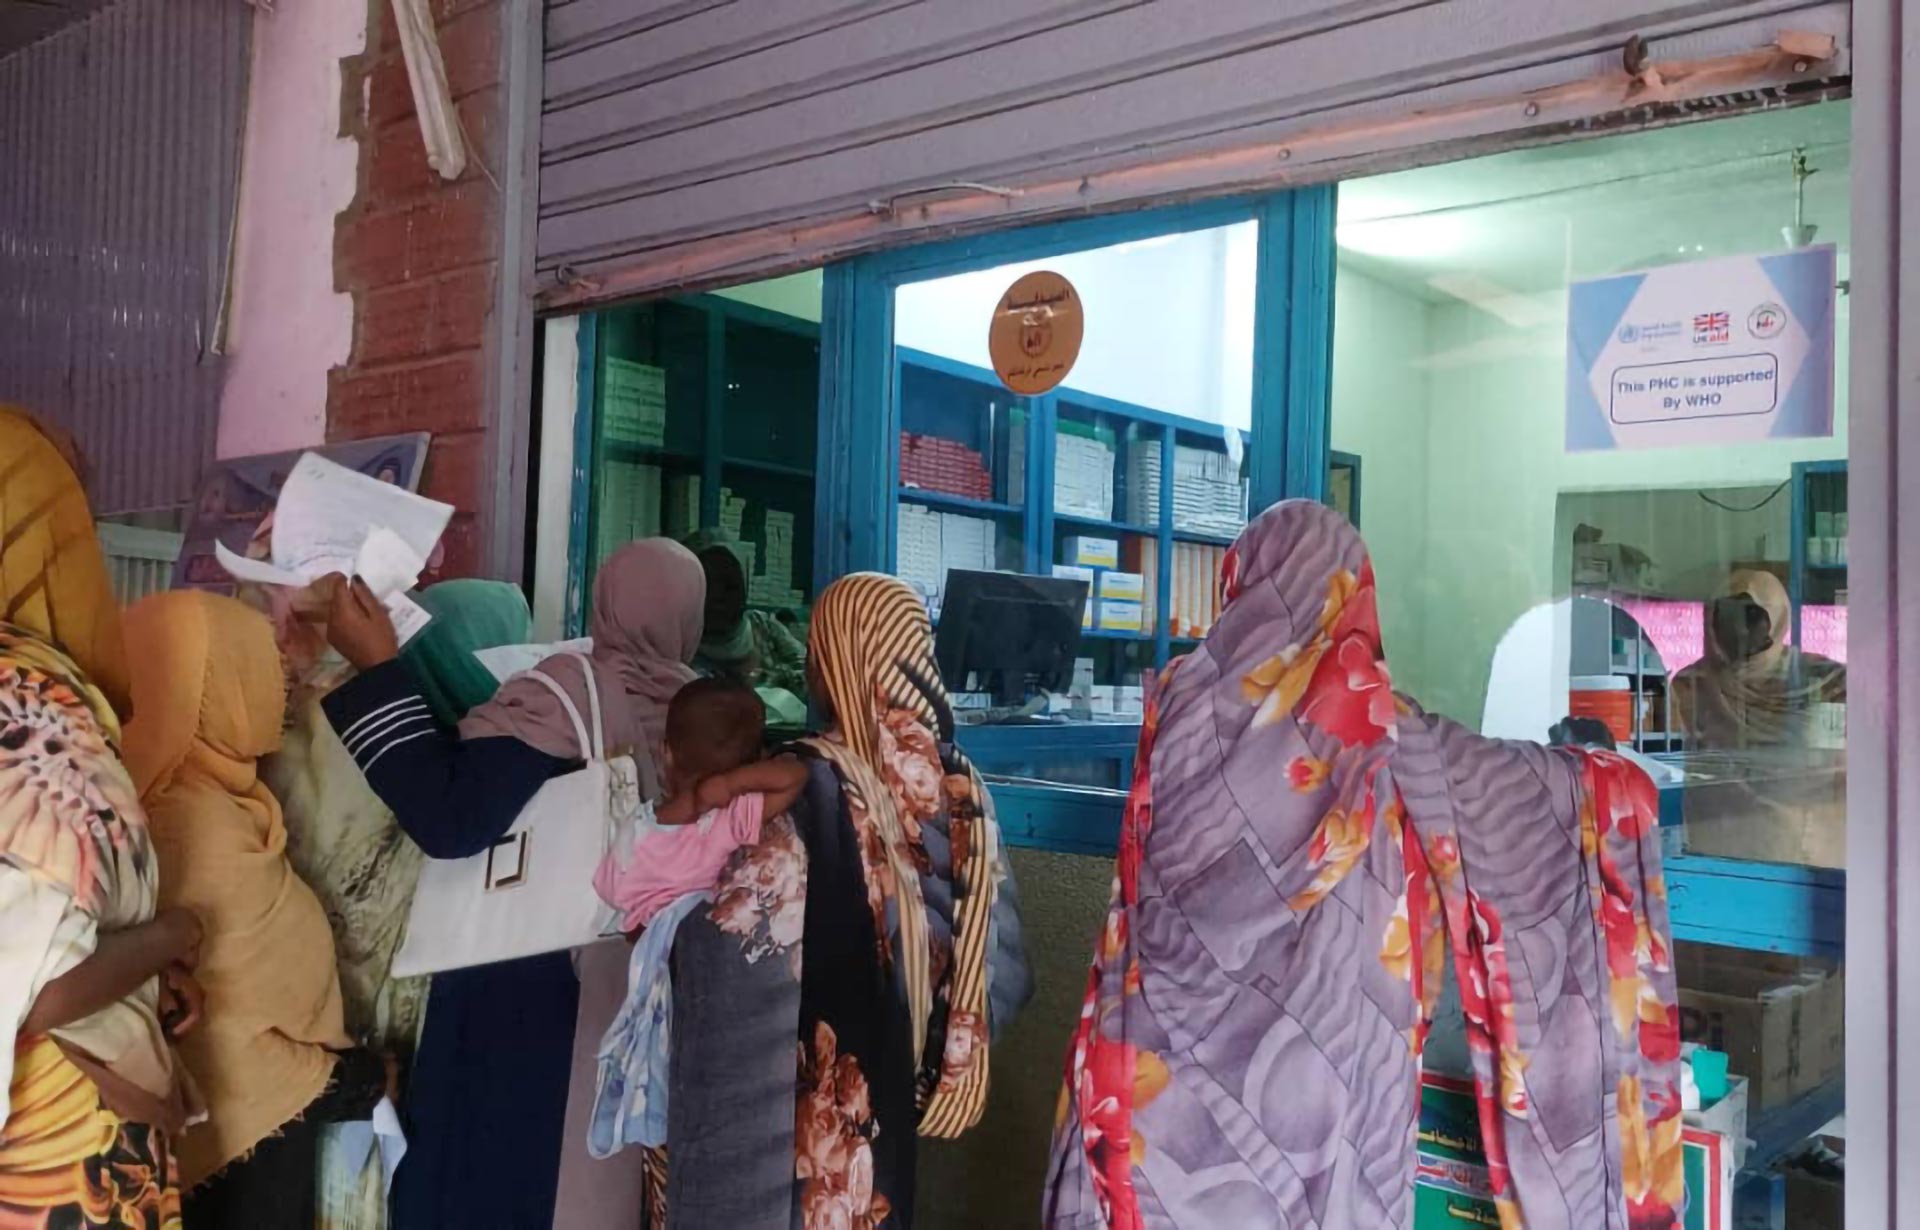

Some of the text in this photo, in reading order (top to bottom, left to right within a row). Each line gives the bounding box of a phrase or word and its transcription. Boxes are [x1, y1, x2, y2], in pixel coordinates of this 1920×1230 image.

[1709, 330, 1729, 343] aid
[1618, 369, 1774, 395] This PHC is supported
[1663, 393, 1722, 410] By WHO
